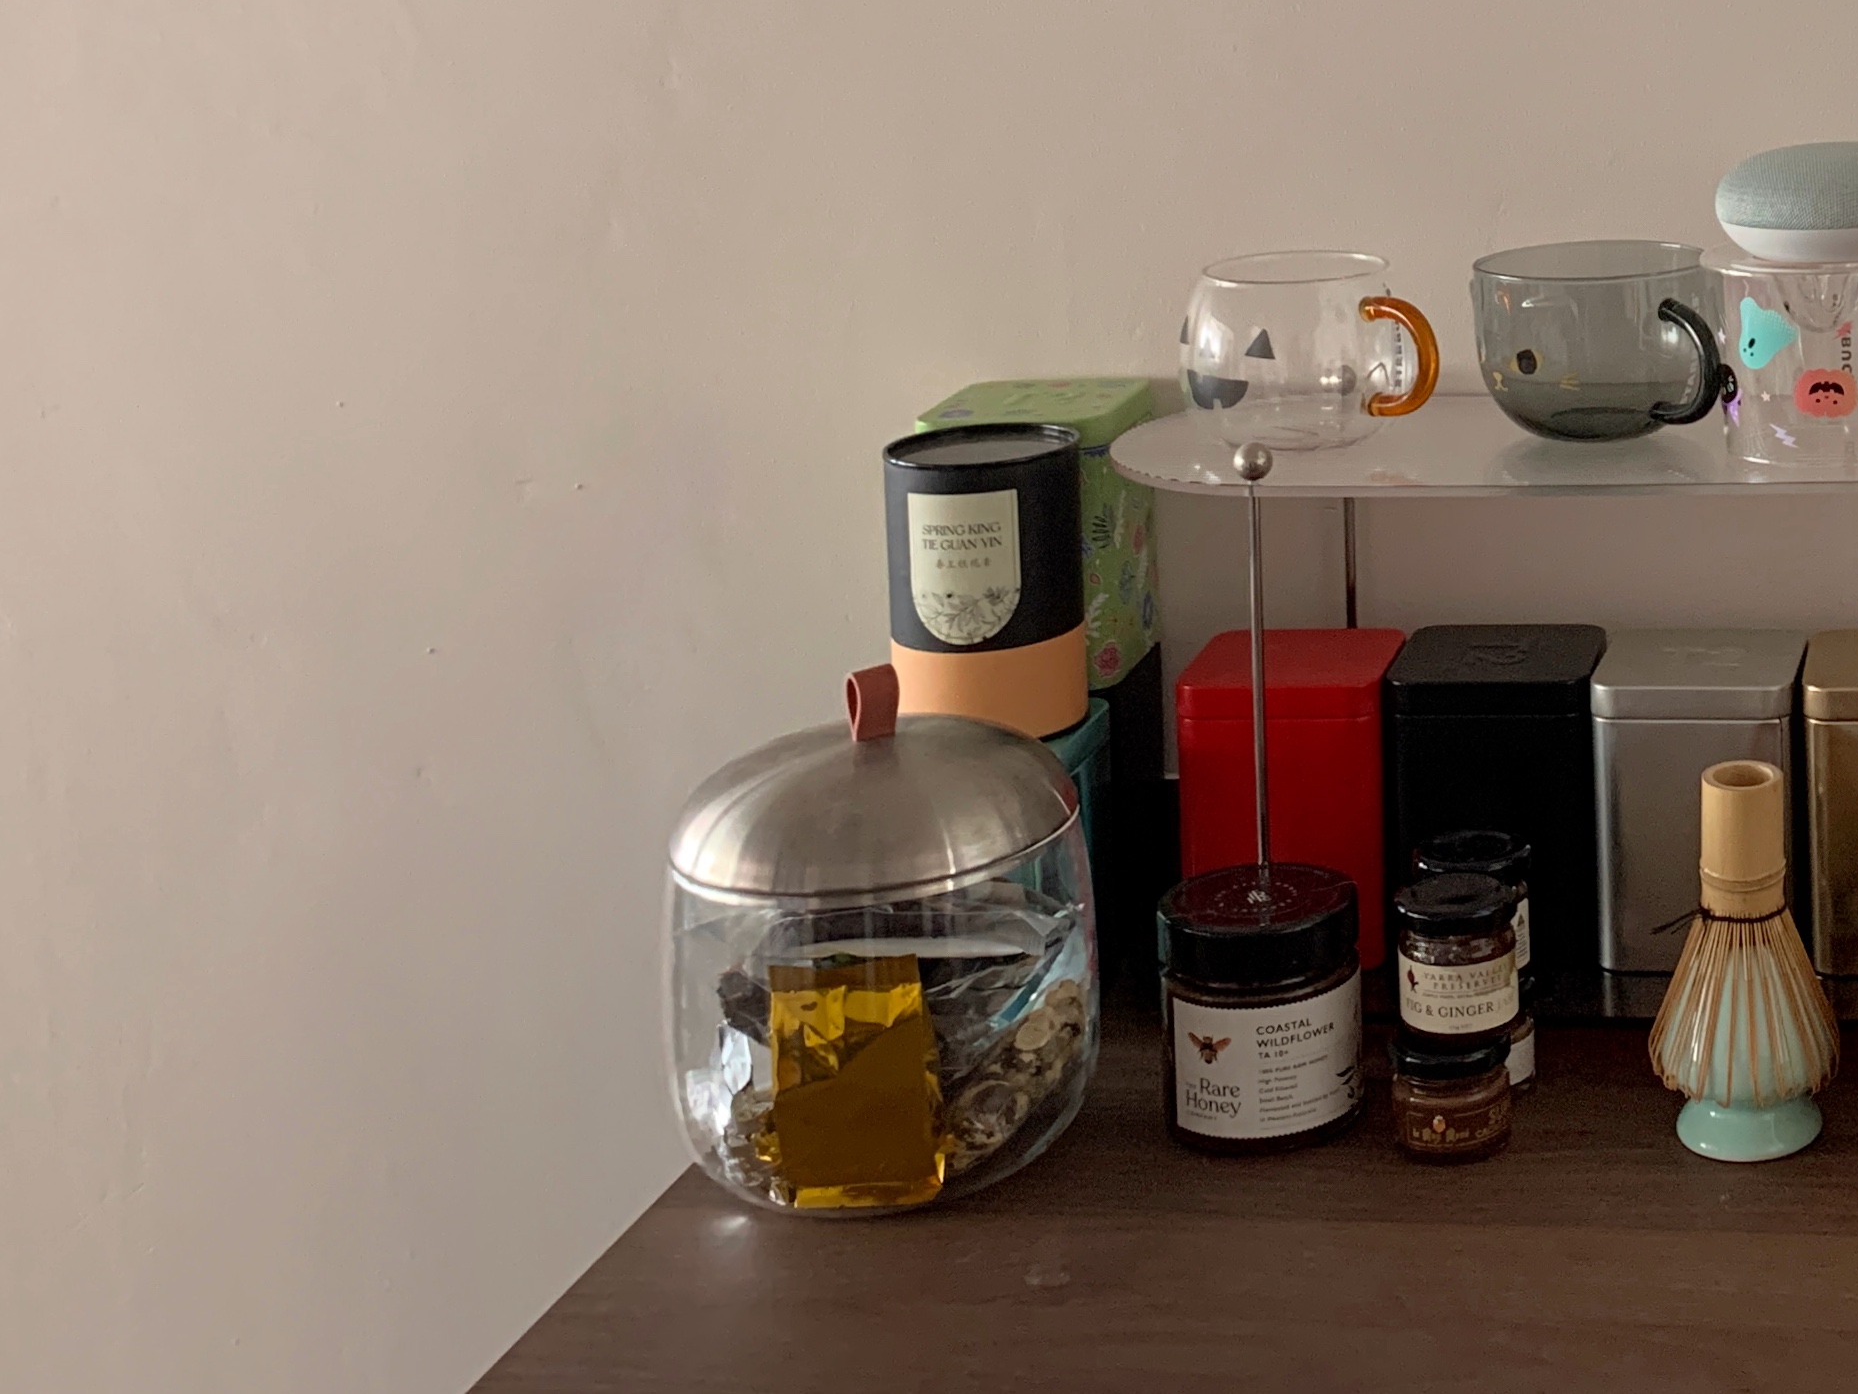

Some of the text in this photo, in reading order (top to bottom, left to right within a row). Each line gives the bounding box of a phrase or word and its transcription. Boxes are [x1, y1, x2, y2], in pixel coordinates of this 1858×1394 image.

[922, 521, 1001, 536] SPRING KING
[922, 536, 1002, 551] TIE GUAN YIN
[1423, 972, 1463, 983] YARRA
[1405, 997, 1422, 1013] FIG
[1426, 1005, 1434, 1016] &
[1438, 1001, 1494, 1018] GINGER
[1256, 1017, 1312, 1035] COASTAL
[1256, 1022, 1335, 1047] WILDFLOWER
[1200, 1077, 1240, 1098] Rare
[1186, 1089, 1241, 1119] Honey
